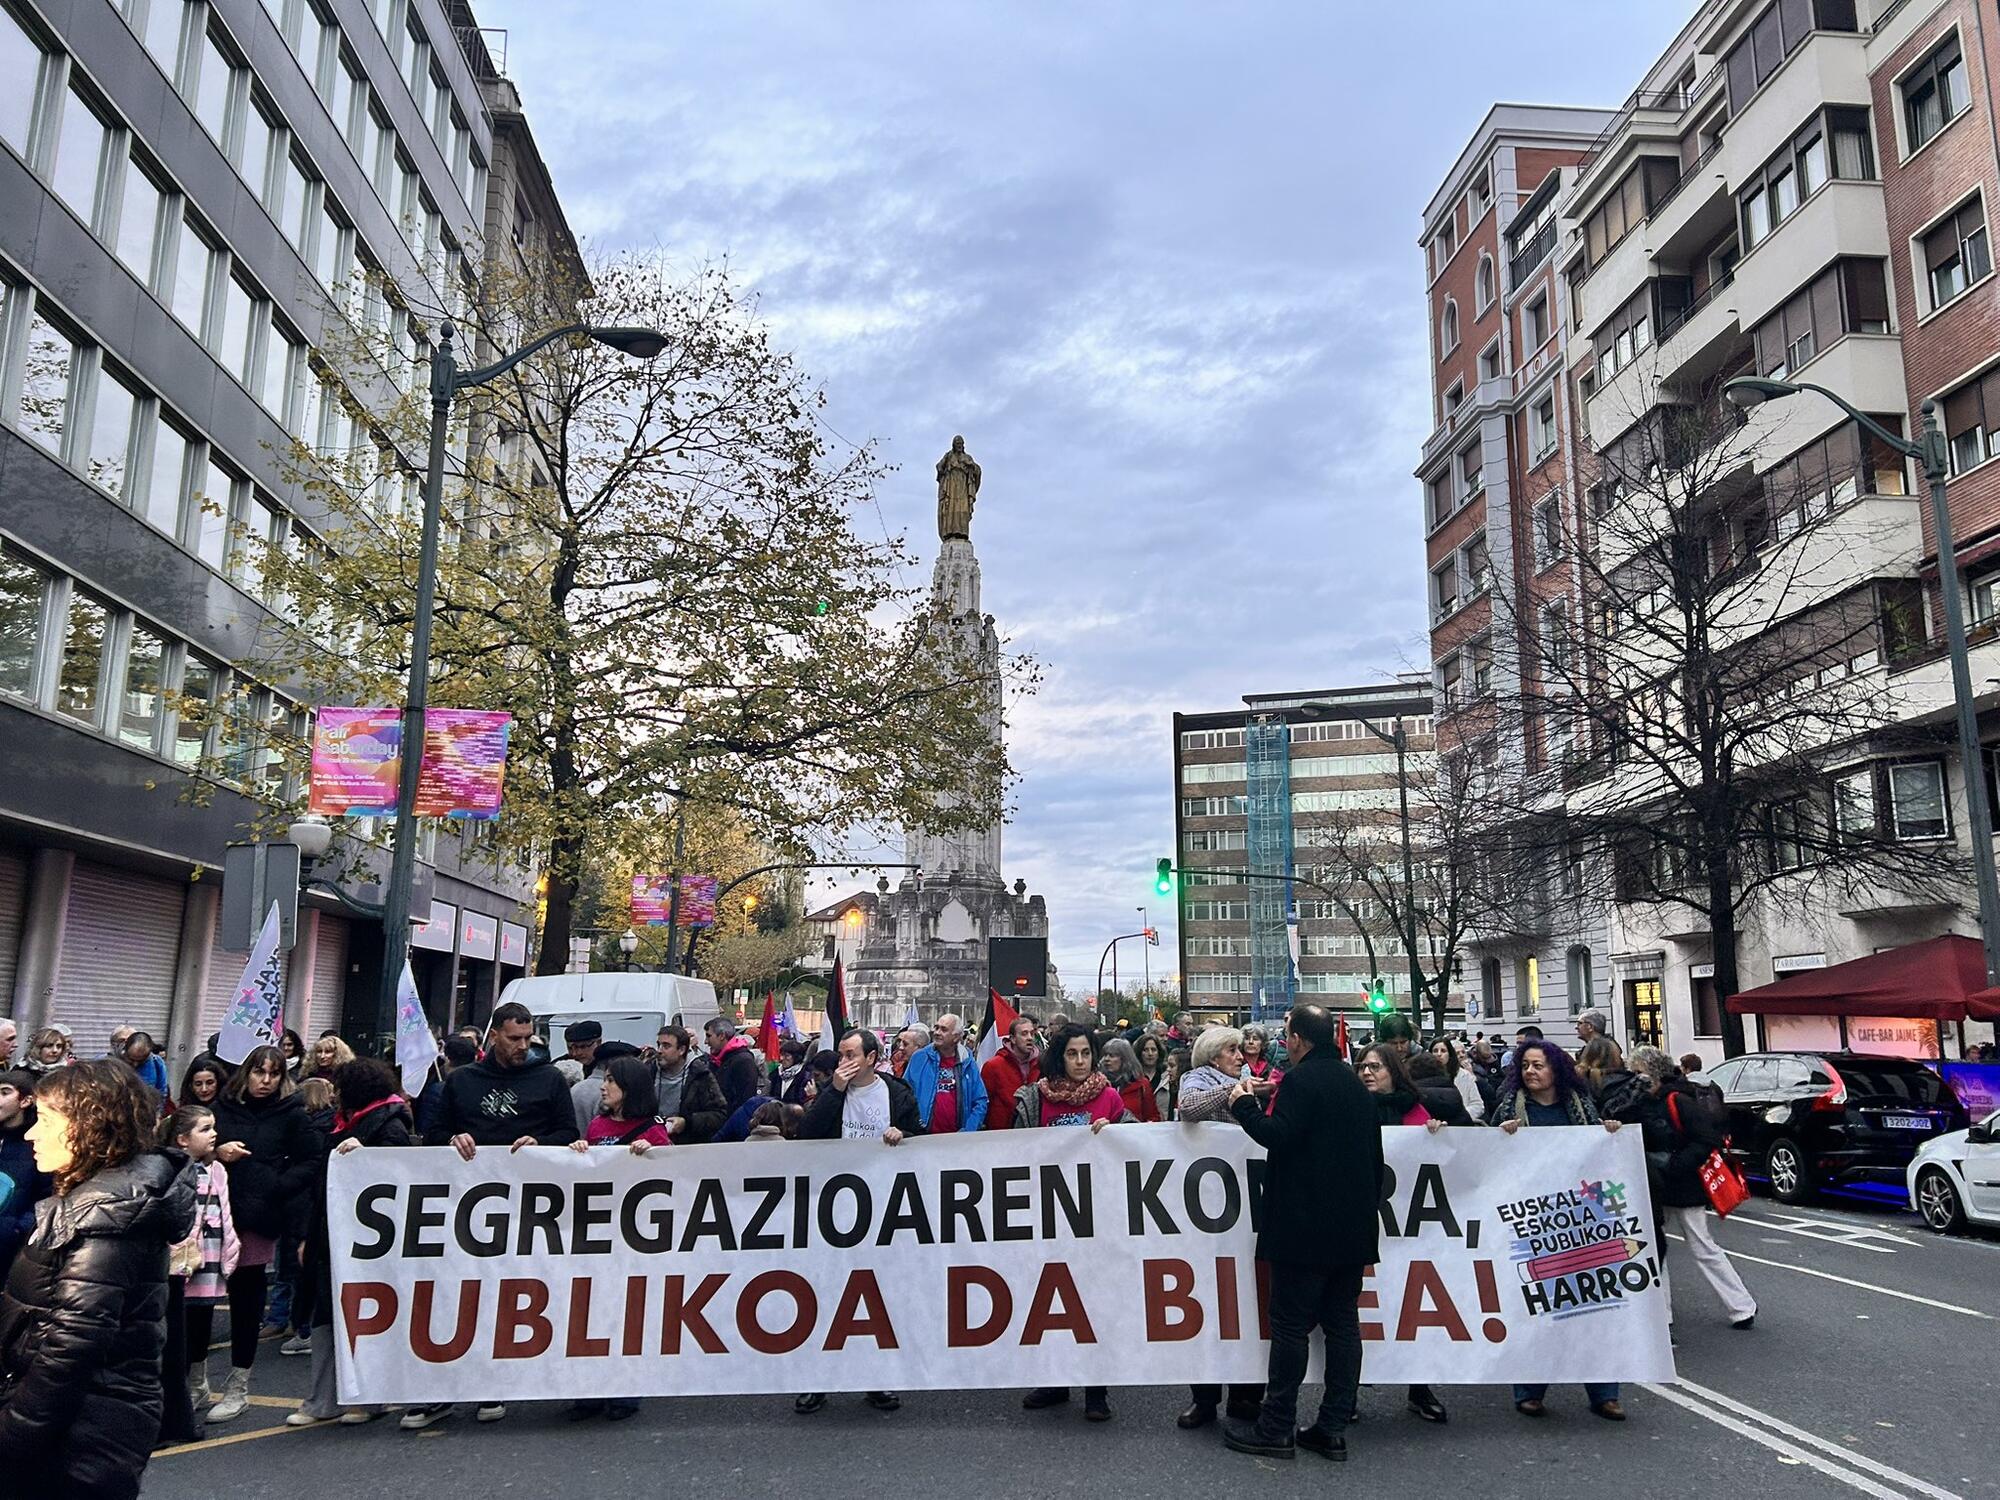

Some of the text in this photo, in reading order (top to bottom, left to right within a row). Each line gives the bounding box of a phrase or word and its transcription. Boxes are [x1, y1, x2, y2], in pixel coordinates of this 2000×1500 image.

[318, 739, 399, 760] Saturday
[1858, 1028, 1918, 1042] CAFE-BAR JAIME
[350, 1157, 1481, 1260] SEGREGAZIOAREN KORA,
[1496, 1189, 1582, 1223] EUSKAL
[1512, 1206, 1597, 1239] ESKOLA
[1529, 1216, 1643, 1257] PUBLIKOAZ
[1520, 1256, 1661, 1316] HARRO!
[340, 1256, 1508, 1364] PUBLIKOA DA BIEA!
